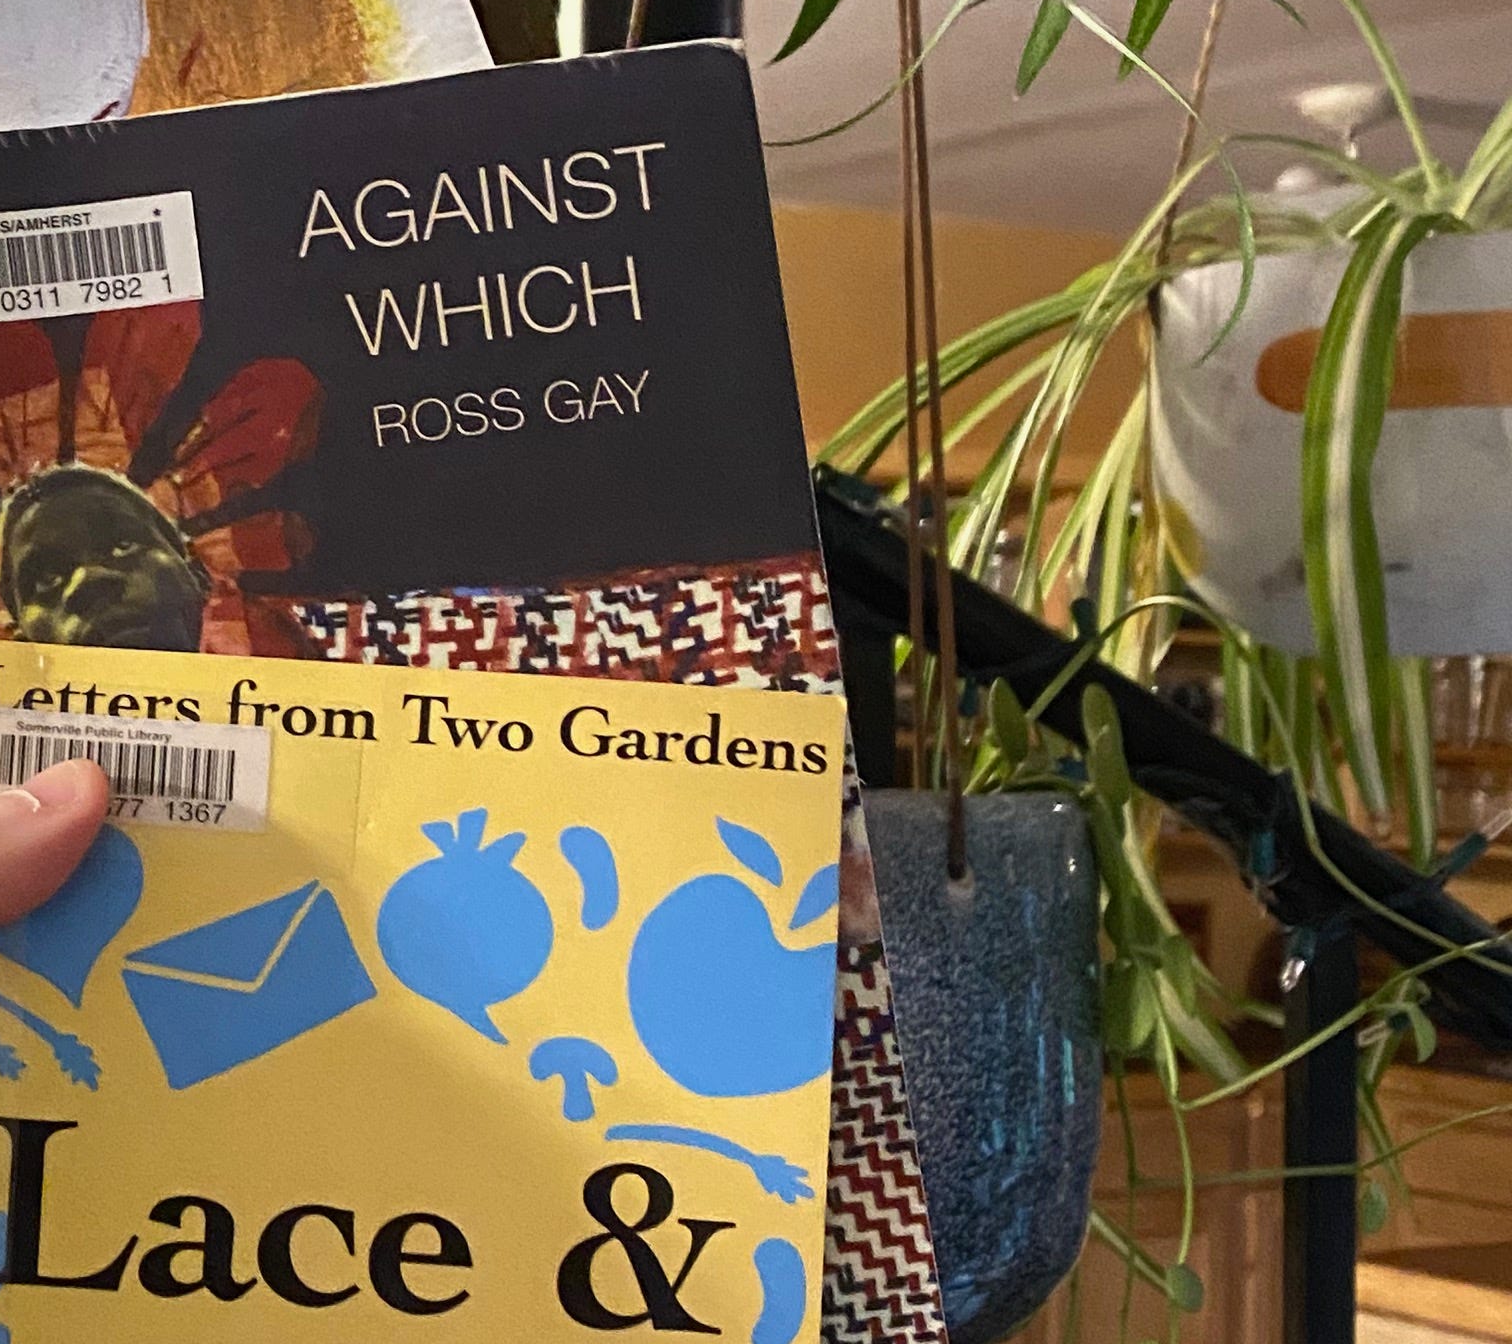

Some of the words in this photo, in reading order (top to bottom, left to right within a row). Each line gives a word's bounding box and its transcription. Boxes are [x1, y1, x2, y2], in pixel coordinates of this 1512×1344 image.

[299, 142, 666, 258] AGAINST
[0, 286, 61, 313] 0311
[79, 276, 143, 304] 7982
[161, 273, 173, 294] 1
[345, 255, 644, 357] WHICH
[373, 388, 525, 449] ROSS
[544, 370, 651, 427] GAY
[16, 720, 82, 736] Somerville
[85, 725, 124, 740] Public
[128, 729, 173, 744] Library
[226, 678, 378, 742] from
[402, 693, 534, 752] Two
[559, 705, 829, 776] Gardens
[107, 798, 144, 819] 77
[165, 800, 227, 824] 1367
[557, 1162, 737, 1335] &
